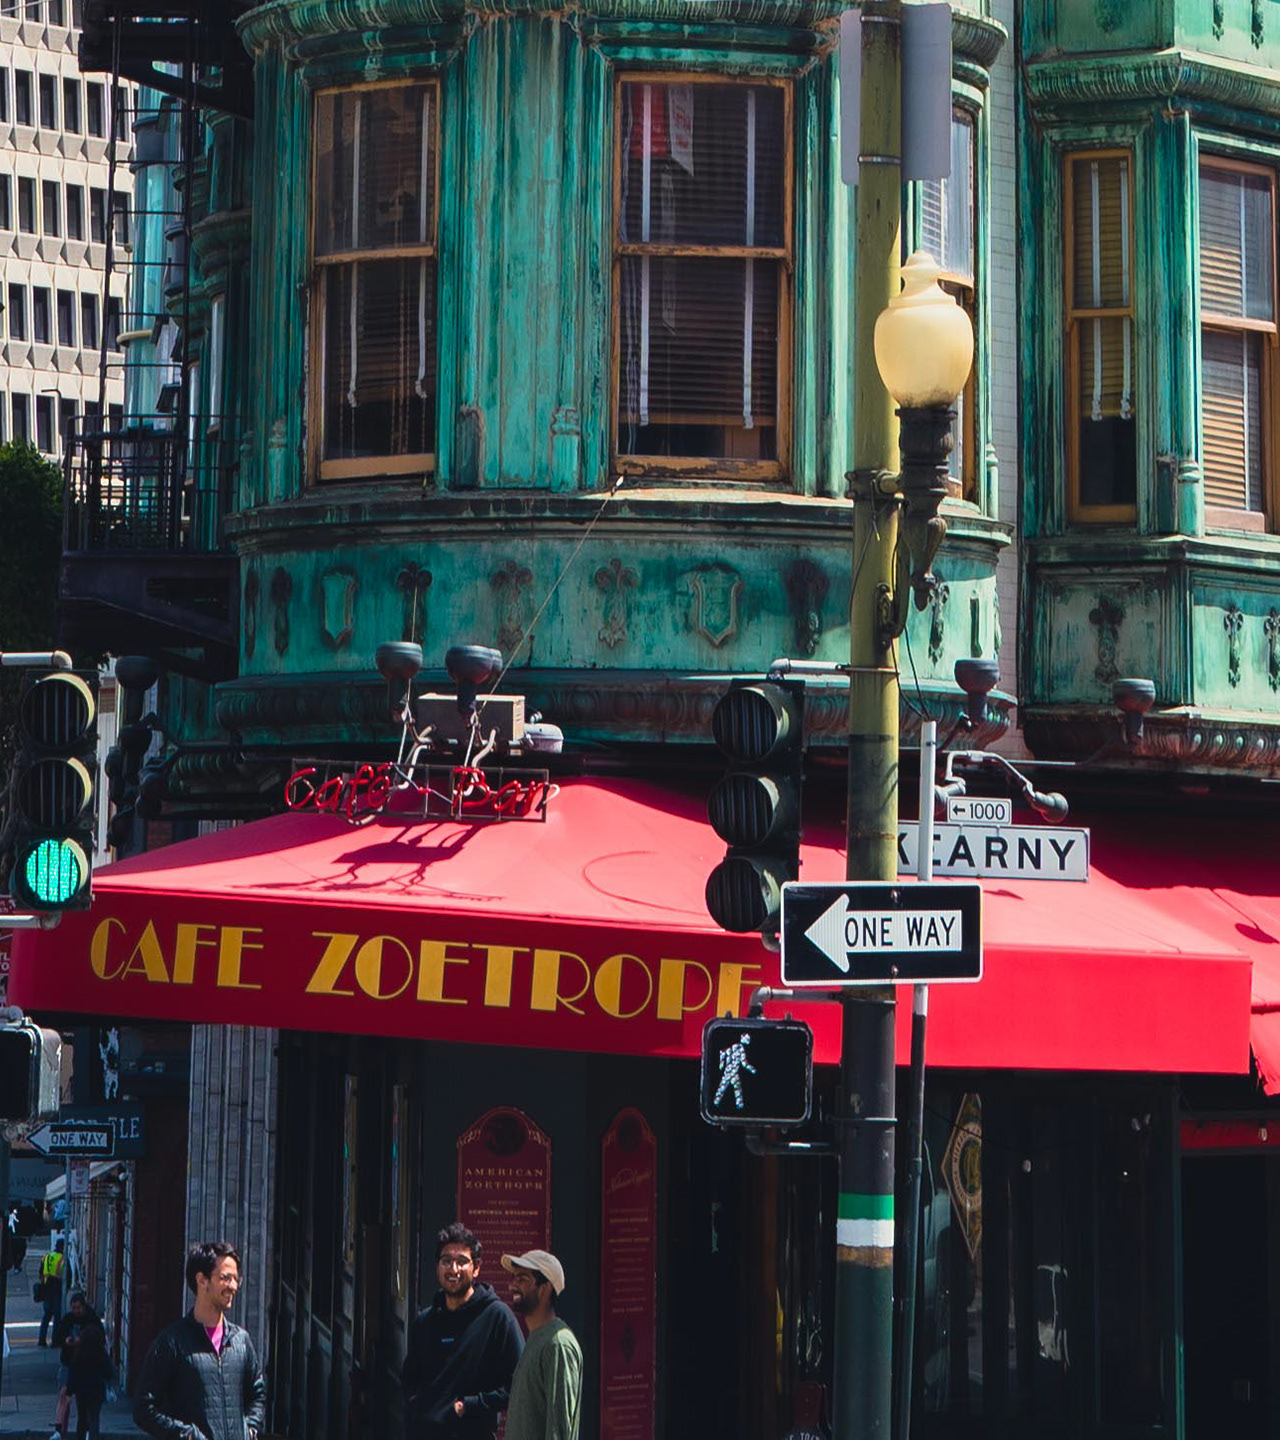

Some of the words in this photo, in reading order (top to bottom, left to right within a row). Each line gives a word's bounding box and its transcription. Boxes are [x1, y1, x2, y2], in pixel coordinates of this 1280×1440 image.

[451, 766, 557, 817] Bar
[969, 802, 1006, 820] 1000
[844, 918, 894, 948] ONE
[906, 916, 956, 947] WAY
[90, 917, 264, 989] CAFE
[304, 931, 763, 1020] ZOETROPE
[51, 1132, 75, 1145] ONE
[79, 1132, 104, 1145] WAY
[465, 1167, 543, 1177] AMERICAN
[464, 1180, 543, 1190] ZOETROPE
